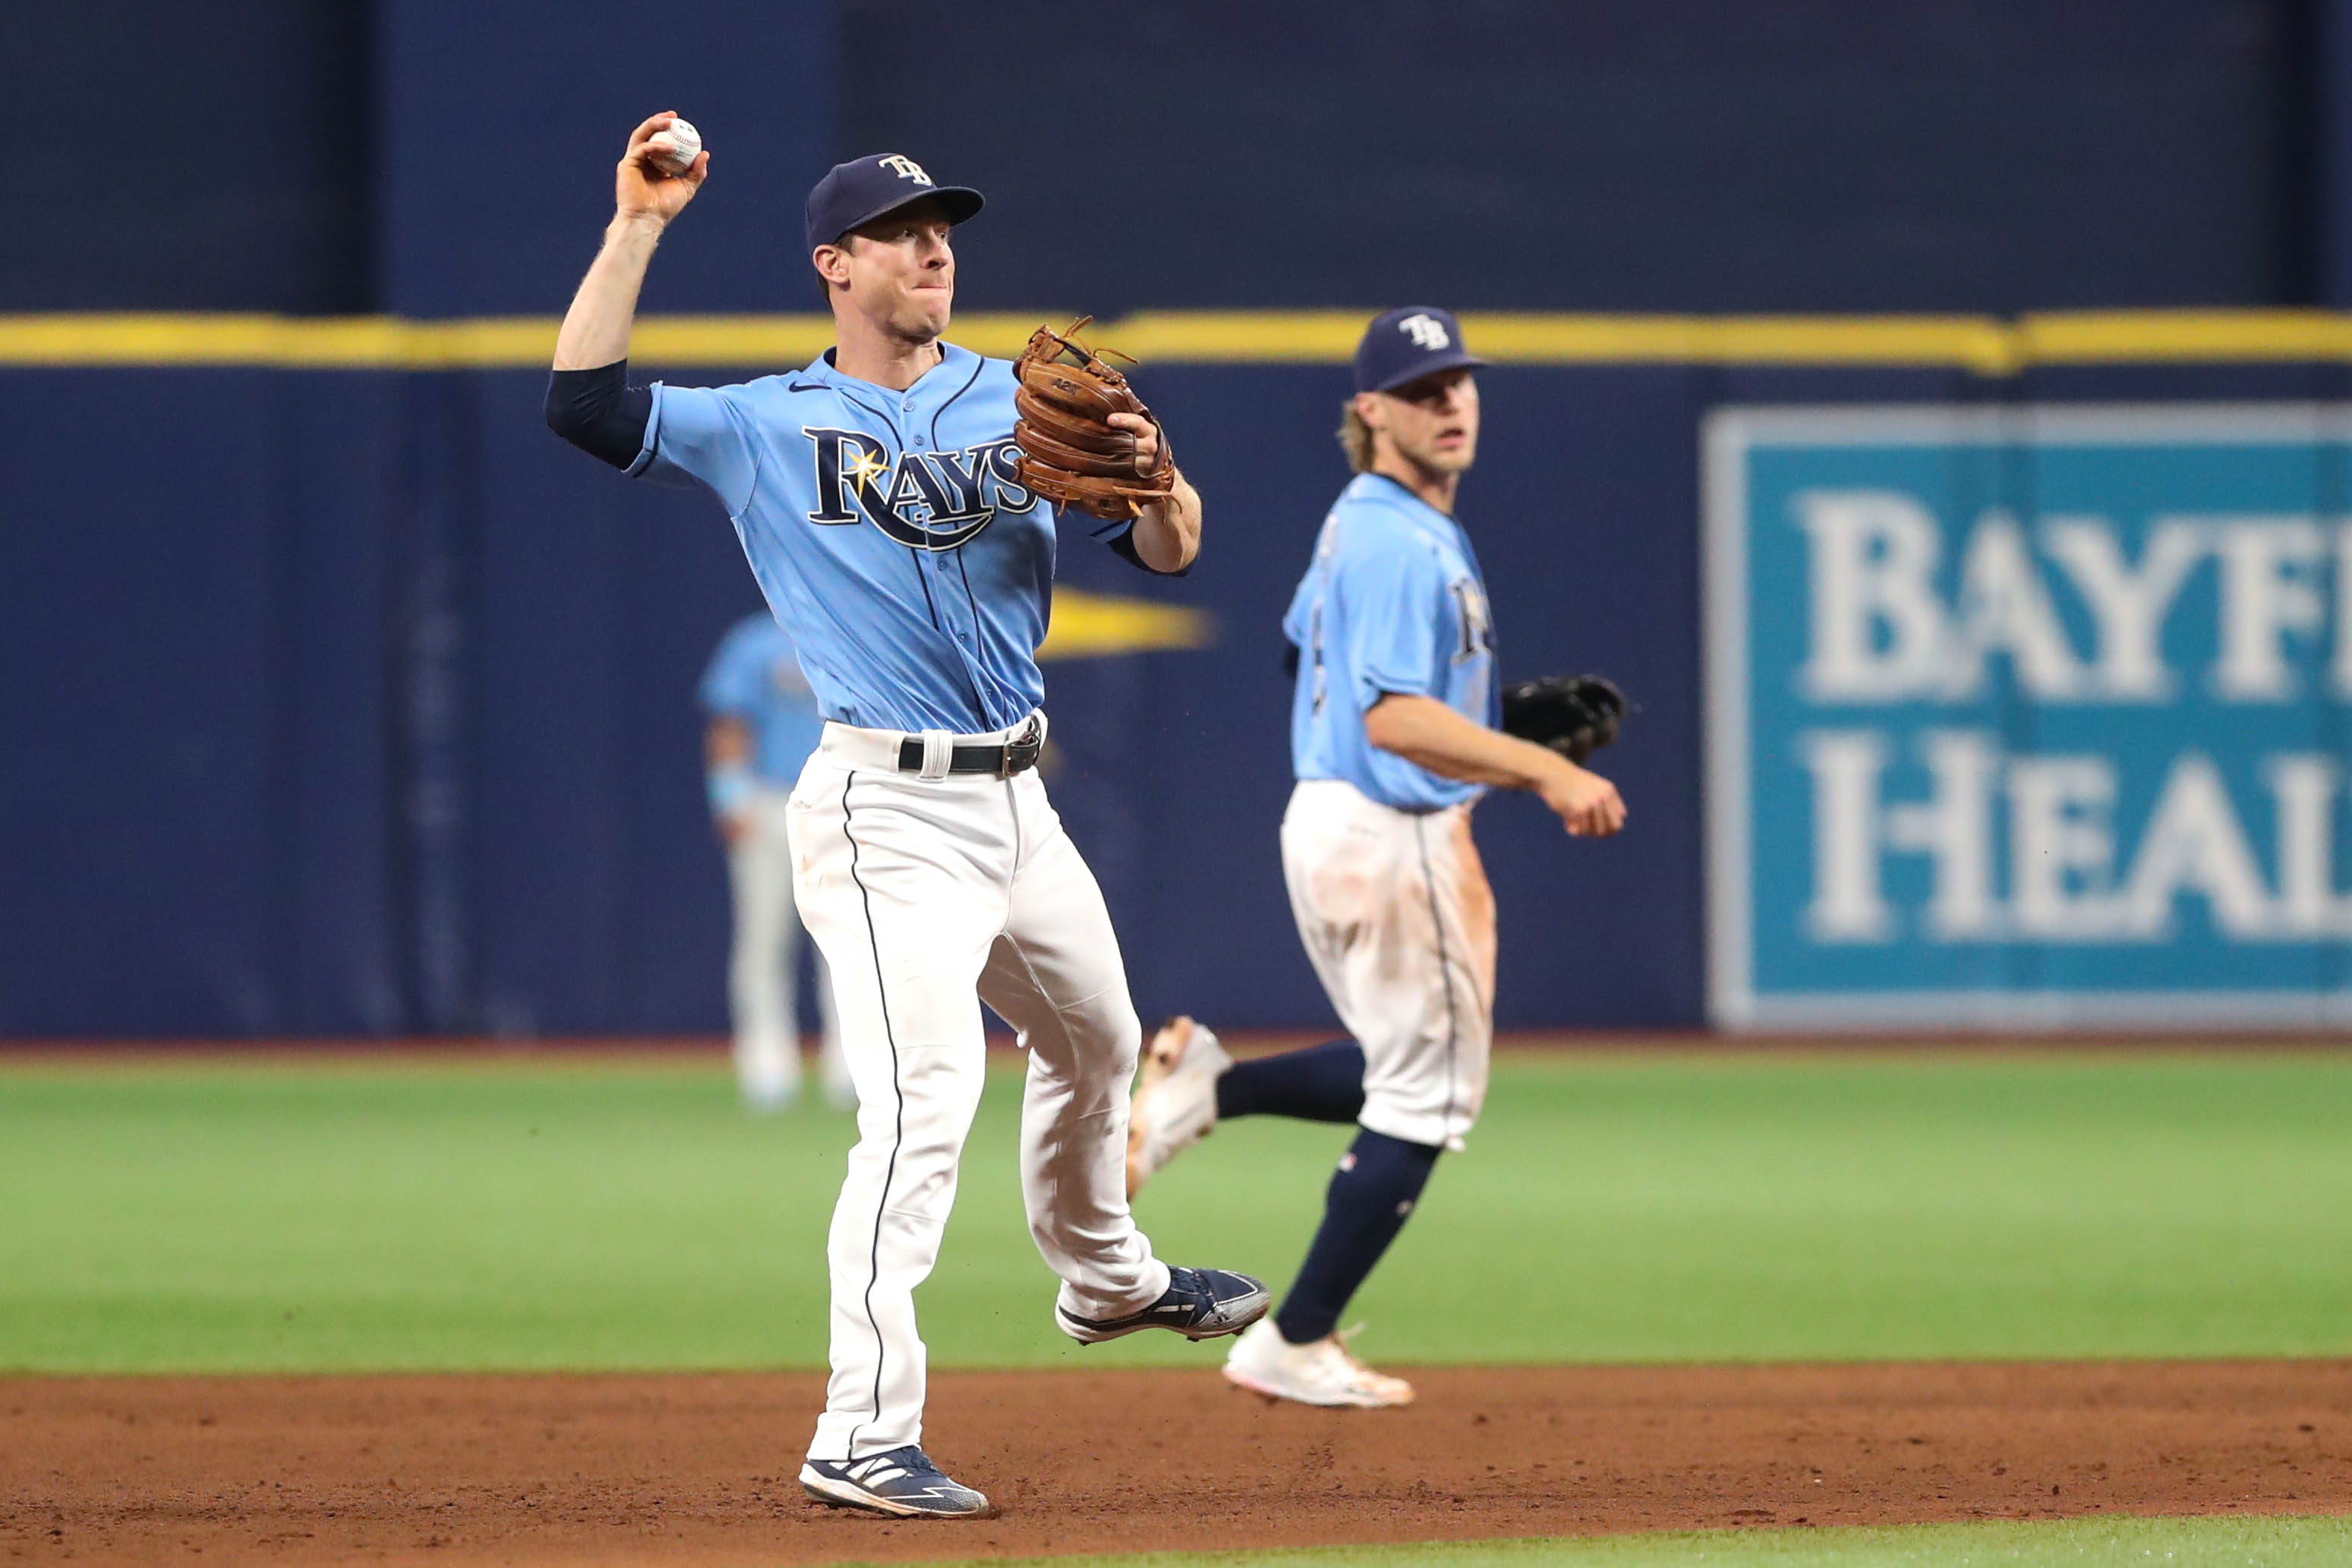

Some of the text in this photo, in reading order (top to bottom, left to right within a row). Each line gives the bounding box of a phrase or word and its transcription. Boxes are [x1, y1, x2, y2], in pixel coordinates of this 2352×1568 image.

[878, 155, 932, 186] TB
[1398, 314, 1450, 350] TB
[801, 425, 1038, 552] RAYS
[1793, 489, 2352, 702] BAYF
